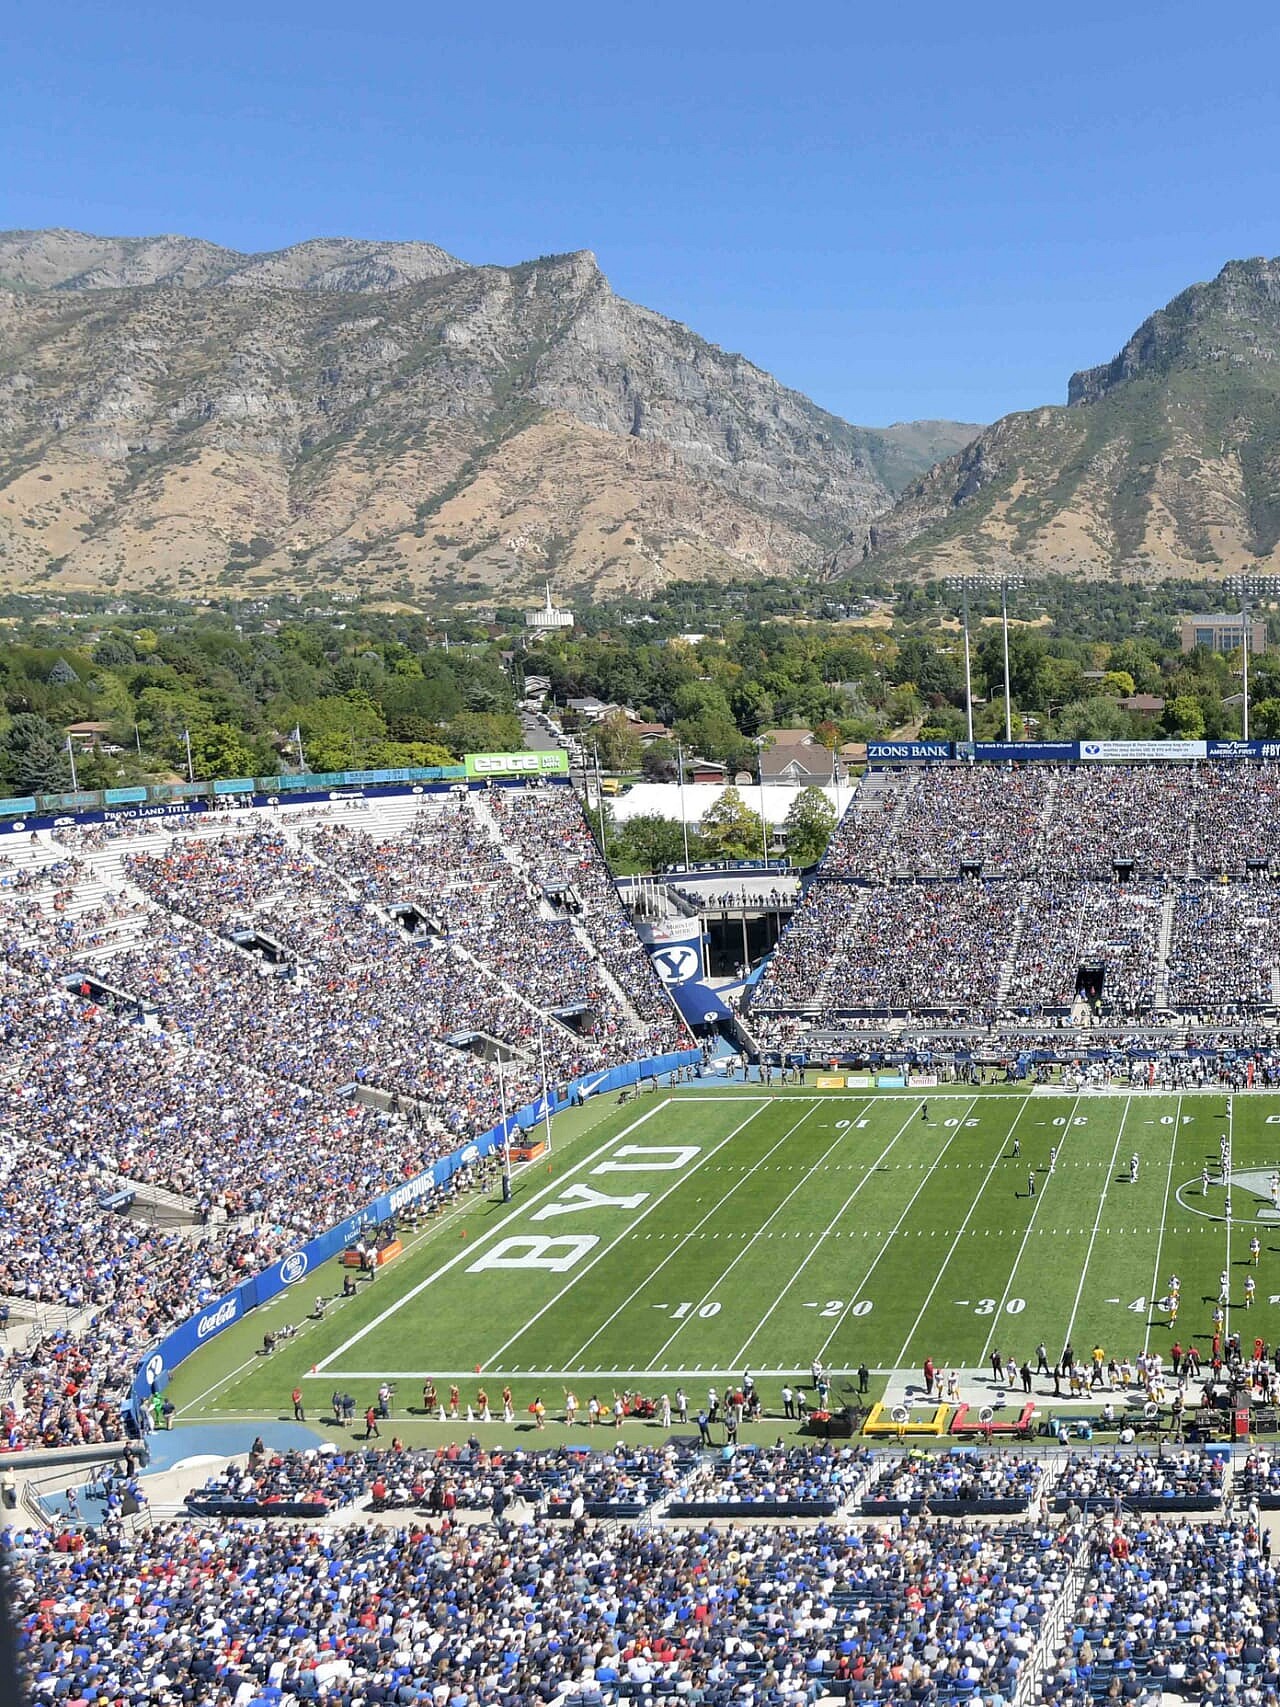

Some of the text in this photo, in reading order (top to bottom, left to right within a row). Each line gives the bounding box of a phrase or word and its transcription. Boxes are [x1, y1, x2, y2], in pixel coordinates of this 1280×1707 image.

[868, 746, 949, 757] ZIONS BANK
[139, 807, 165, 816] LAND
[166, 804, 190, 813] TITLE
[654, 951, 691, 978] Y
[390, 1171, 435, 1212] #GOCOUGS
[464, 1143, 703, 1273] BYU
[668, 1302, 721, 1318] 10
[819, 1300, 874, 1317] 20
[974, 1299, 1026, 1315] 30
[197, 1297, 237, 1338] Coca-Cola
